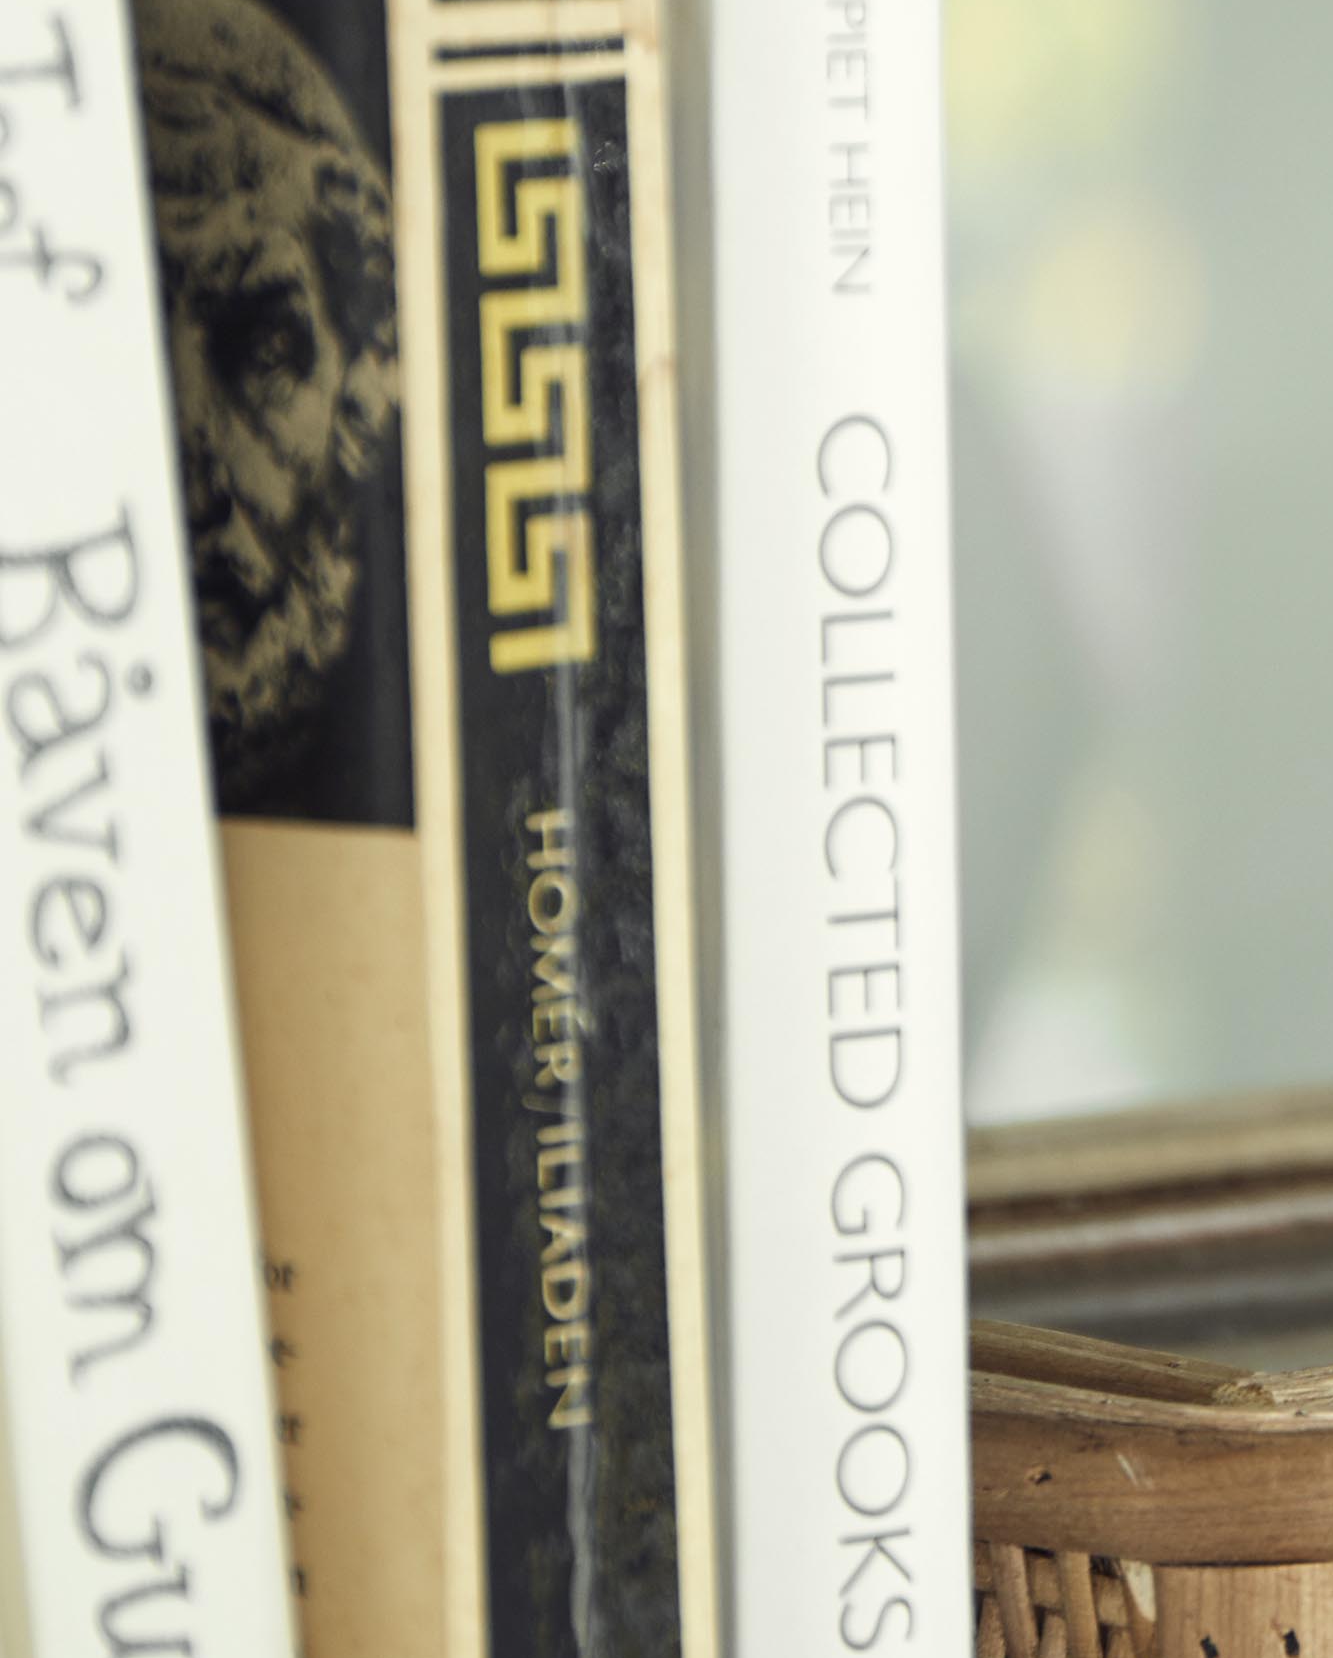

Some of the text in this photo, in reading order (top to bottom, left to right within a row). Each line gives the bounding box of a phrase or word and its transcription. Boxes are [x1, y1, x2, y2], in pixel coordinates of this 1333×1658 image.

[828, 139, 873, 296] HEIN
[815, 411, 904, 1113] COLLECTED
[48, 1127, 162, 1385] om
[828, 1149, 916, 1655] GROOKS
